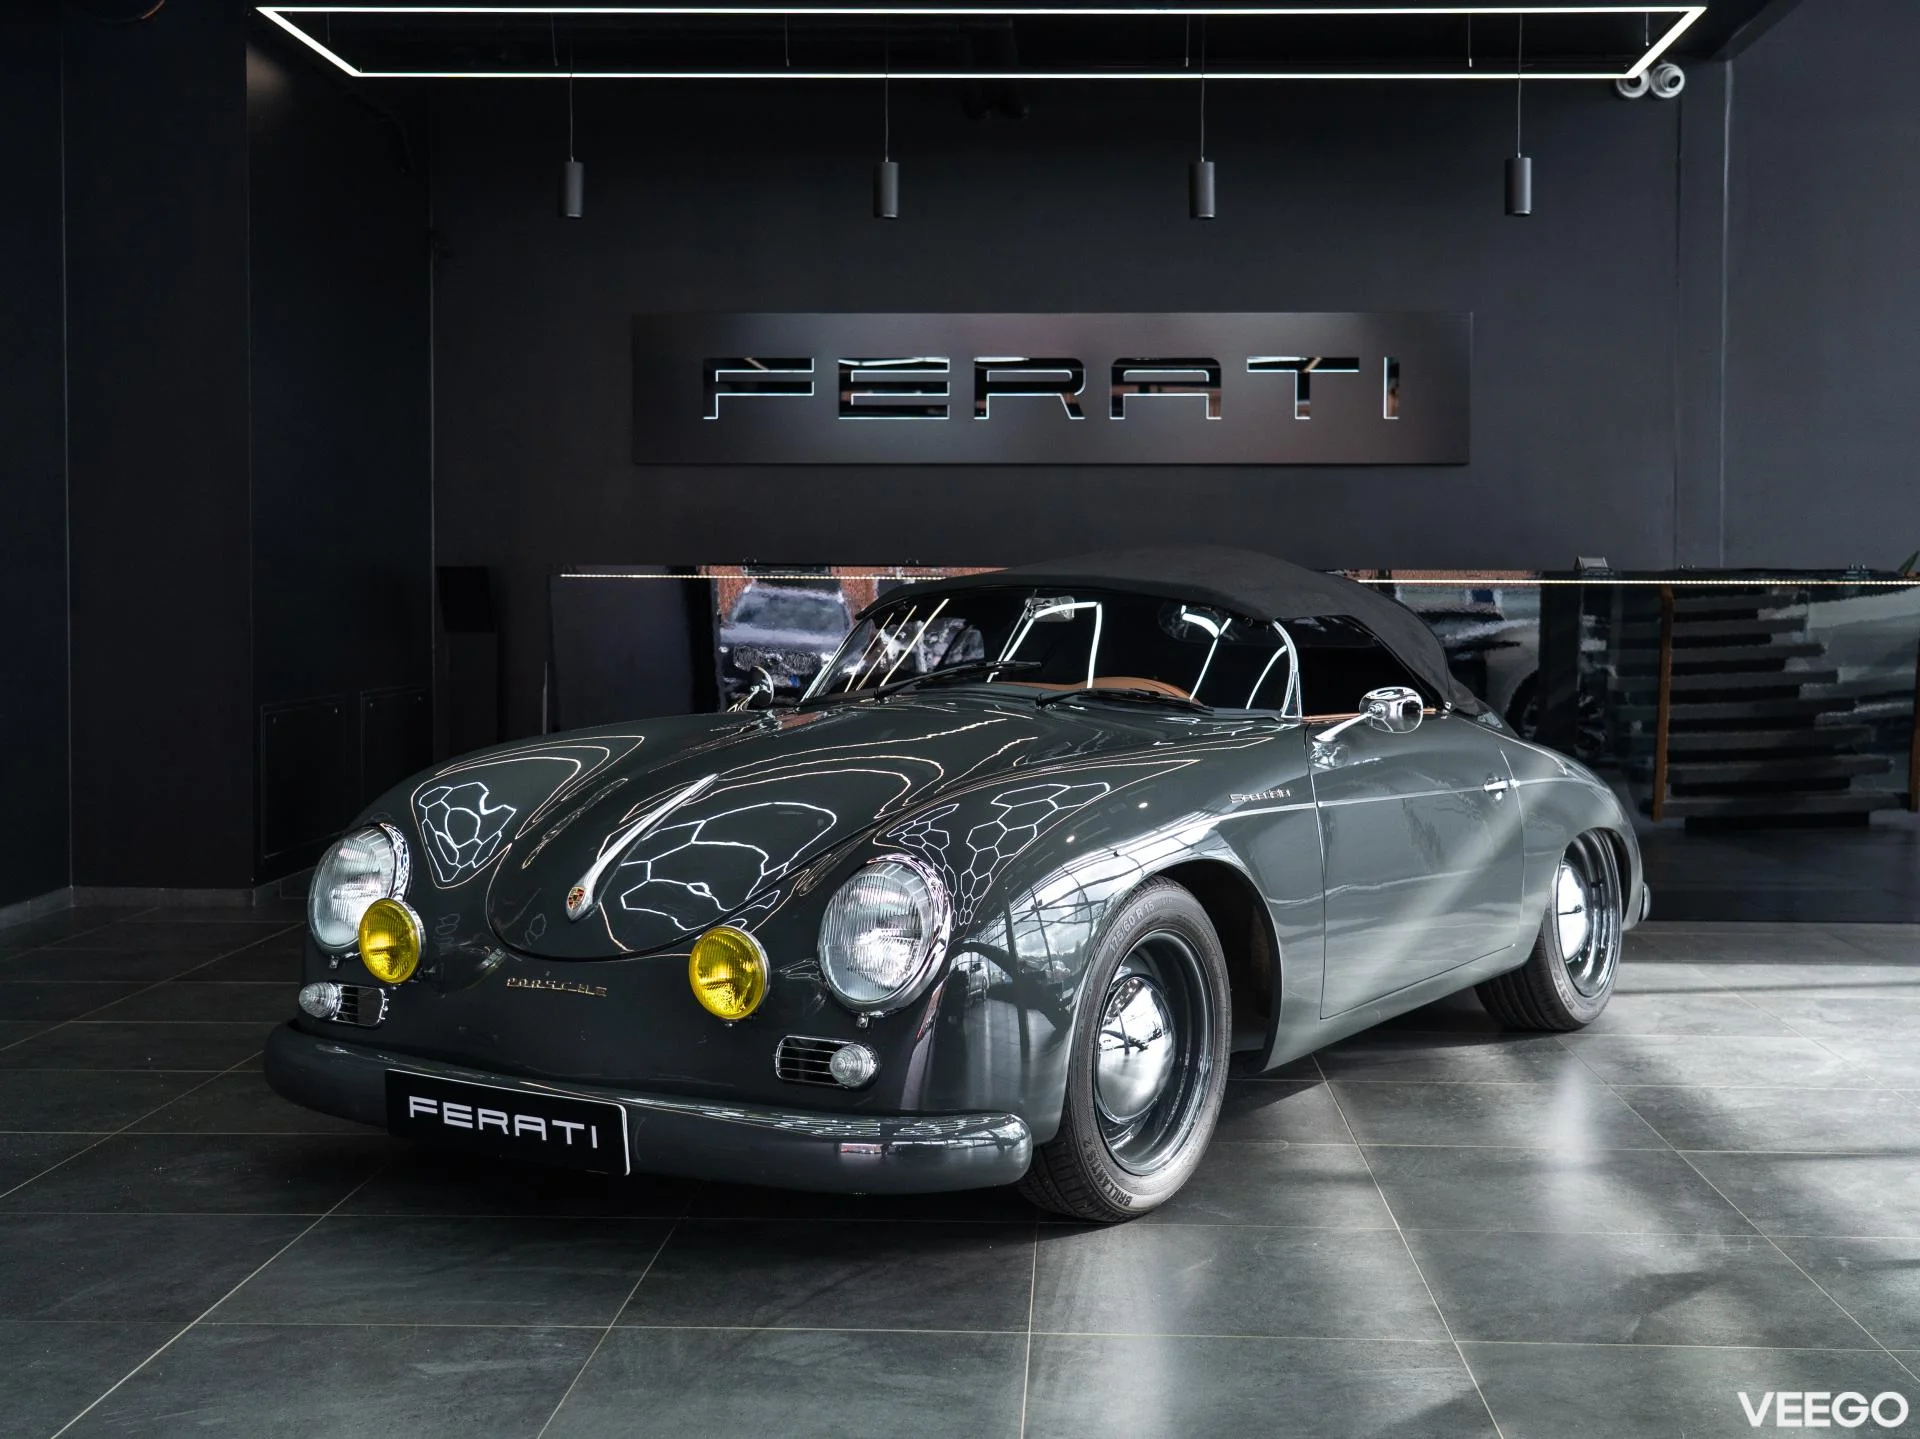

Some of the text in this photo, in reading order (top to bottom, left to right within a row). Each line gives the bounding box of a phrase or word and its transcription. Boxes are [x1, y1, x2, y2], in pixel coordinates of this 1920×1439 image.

[703, 356, 1399, 420] FERATI
[1135, 908, 1143, 920] R
[507, 978, 607, 997] PORSCHE
[409, 1095, 598, 1149] FERATI
[1086, 1151, 1133, 1207] BRILLANTIS
